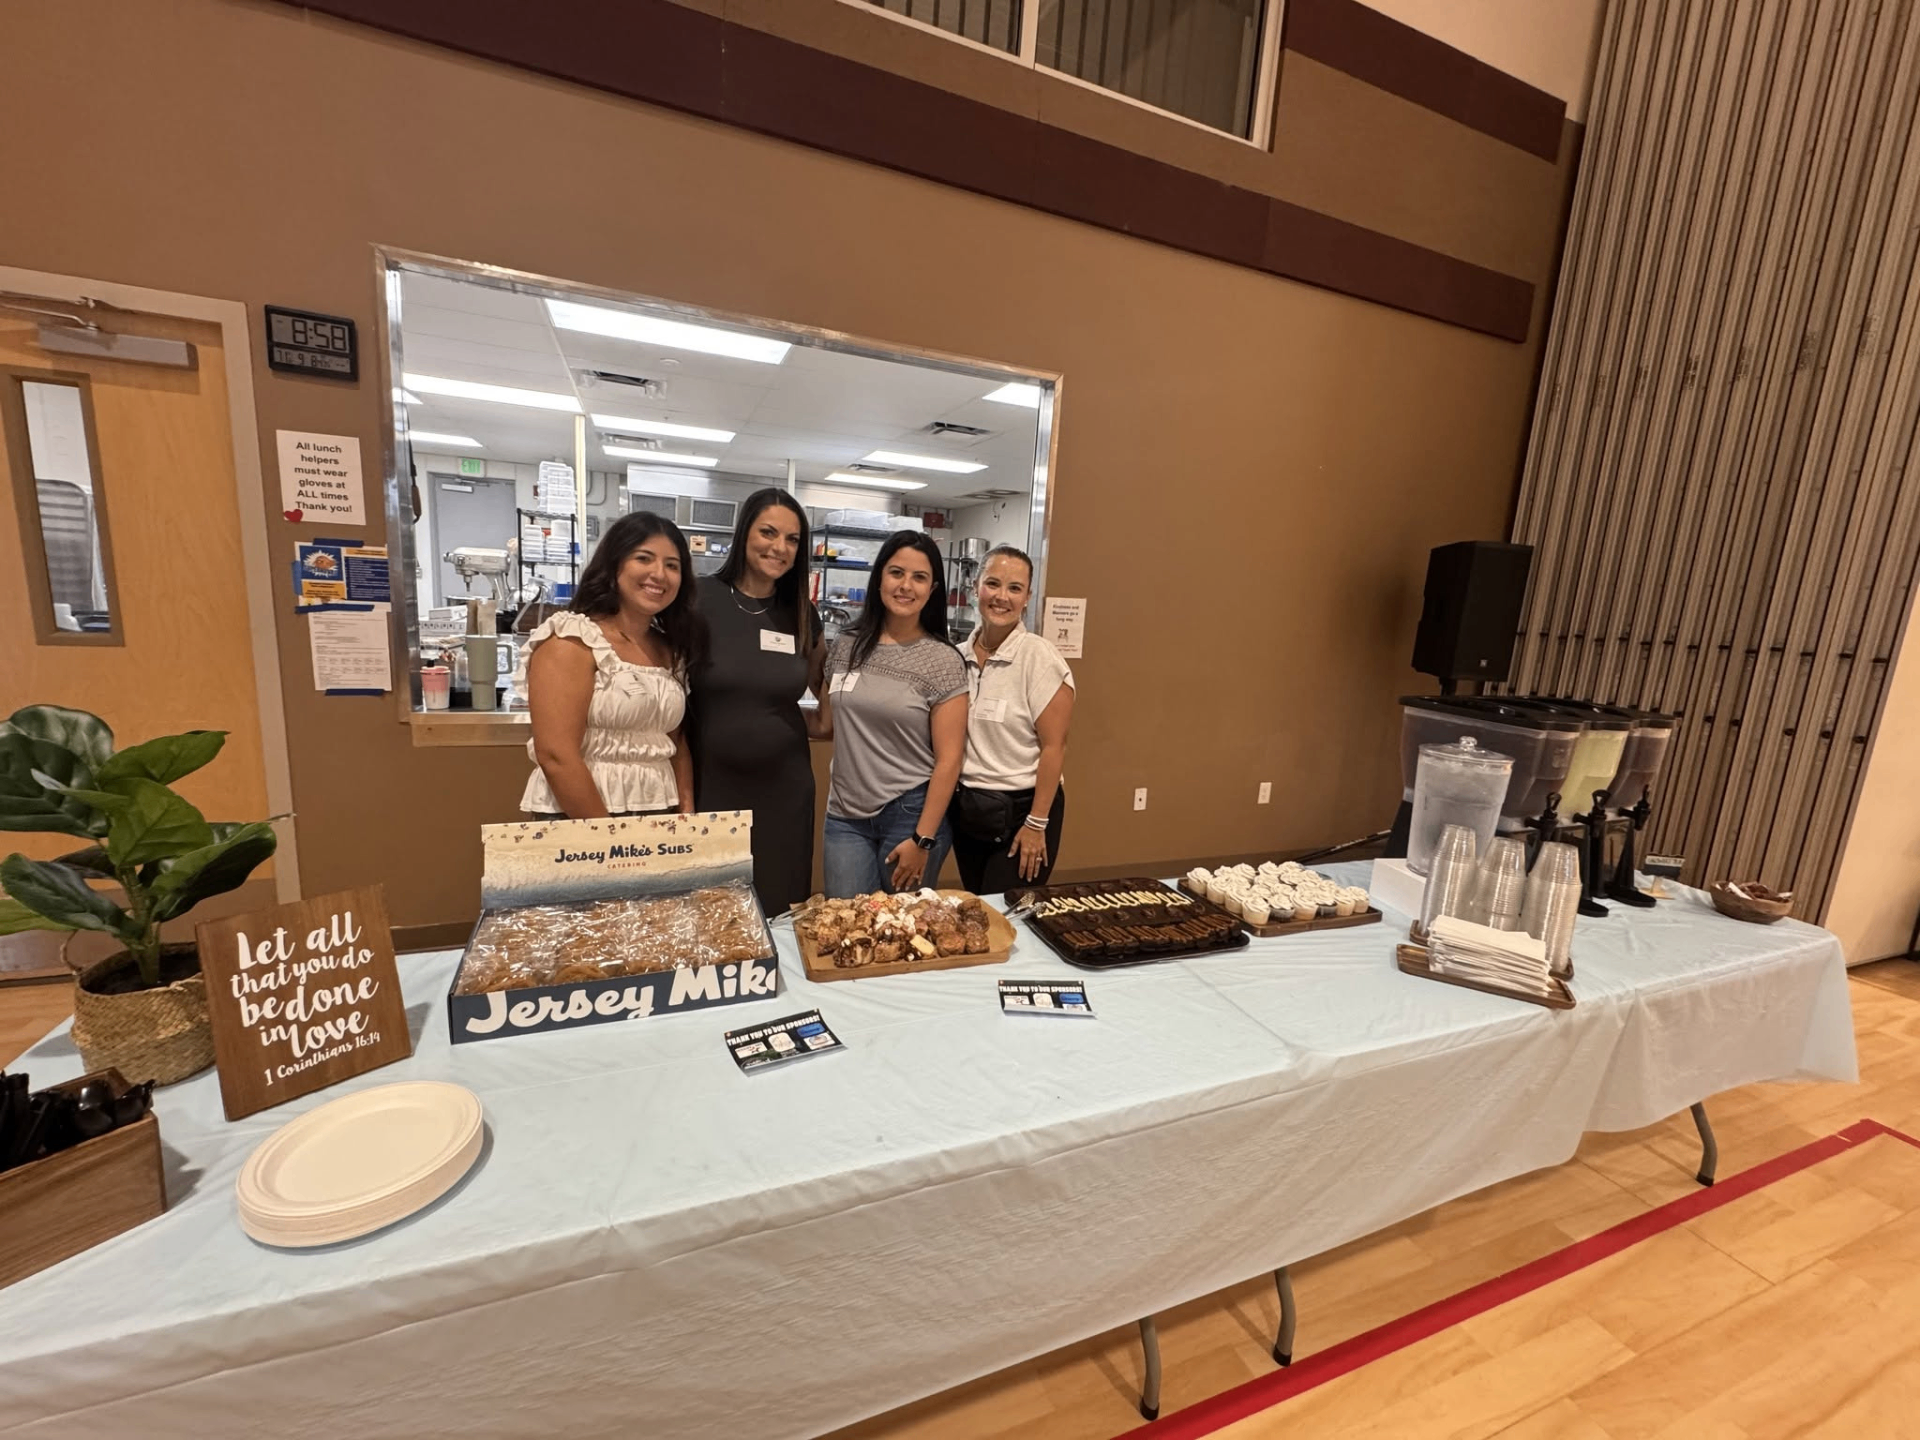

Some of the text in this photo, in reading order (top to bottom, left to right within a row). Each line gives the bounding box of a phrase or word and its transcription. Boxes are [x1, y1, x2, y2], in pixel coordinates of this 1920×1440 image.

[292, 319, 346, 351] 8:58
[296, 441, 342, 453] All lunch
[300, 454, 340, 465] helpers
[294, 467, 321, 475] must
[298, 479, 333, 487] gloves
[295, 501, 353, 513] Thank you!
[297, 490, 349, 501] ALL times
[554, 848, 606, 864] Jersey
[609, 844, 654, 859] Mike's
[607, 861, 647, 869] CATERING
[236, 911, 362, 970] Let all
[230, 946, 374, 999] that you do
[238, 976, 379, 1028] be done
[466, 985, 655, 1034] Jersey
[259, 1010, 369, 1059] in love
[727, 1033, 750, 1046] THANK
[750, 1030, 764, 1039] YOU
[763, 1028, 773, 1036] TO
[786, 1015, 820, 1029] SPONSORS!
[264, 1031, 381, 1086] 1 Corinthians 16:14
